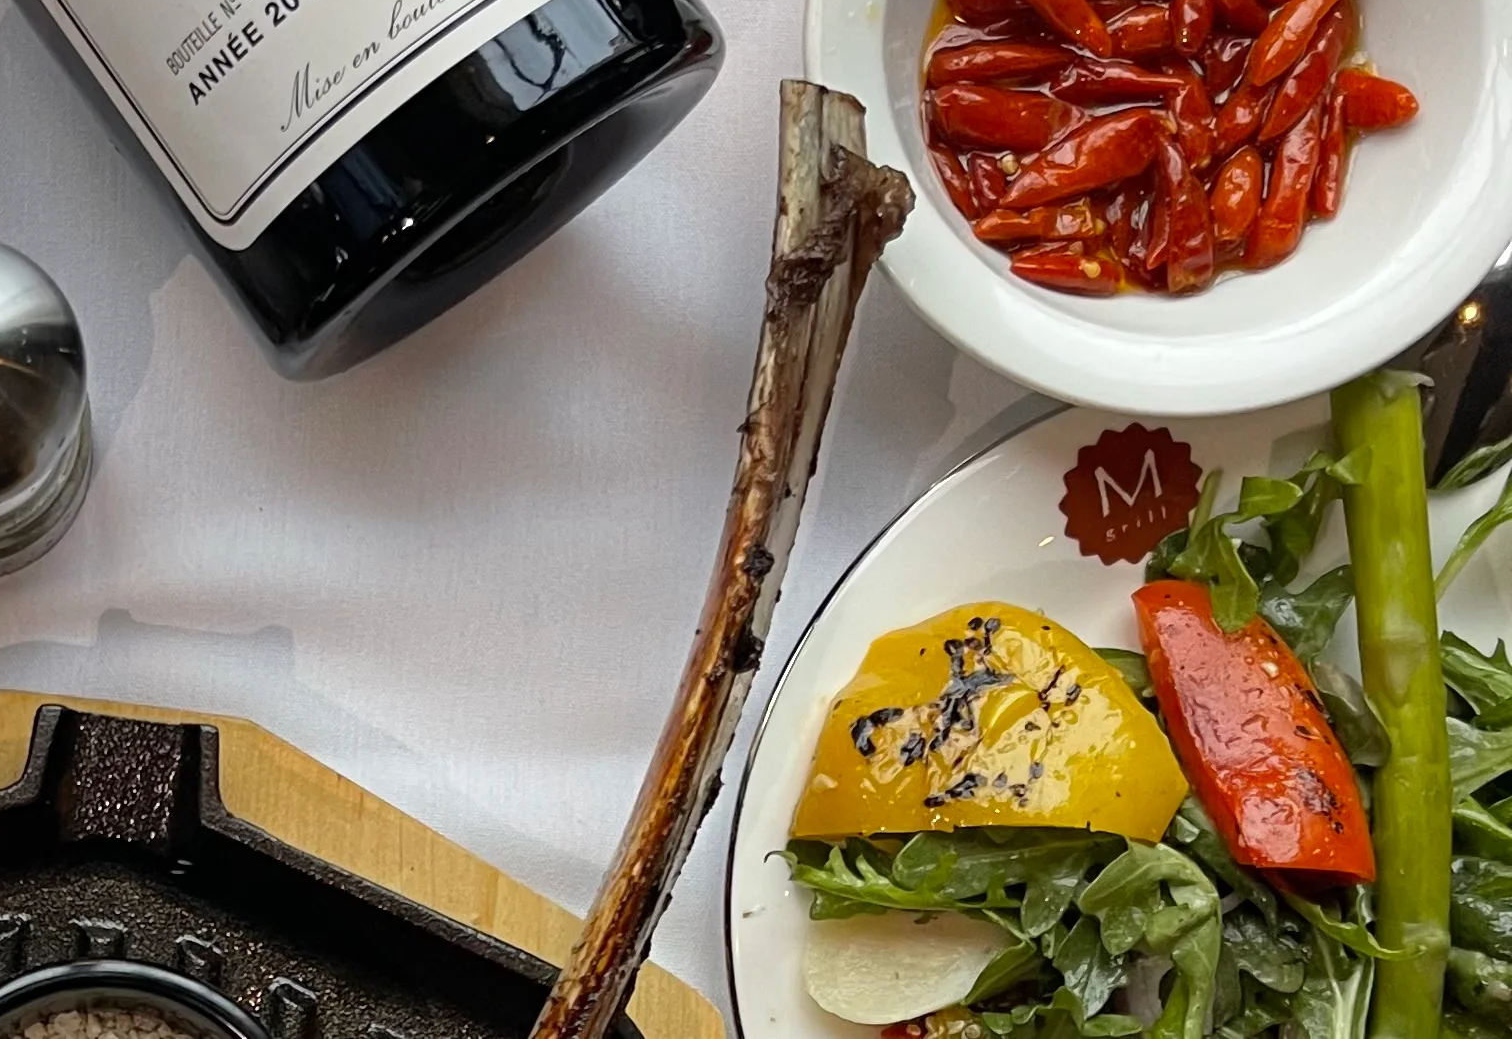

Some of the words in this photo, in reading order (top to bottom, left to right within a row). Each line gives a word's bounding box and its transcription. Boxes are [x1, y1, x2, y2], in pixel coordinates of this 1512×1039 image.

[165, 11, 223, 76] BOUTEILLE
[188, 20, 265, 107] ANNÉE
[280, 61, 346, 133] Mise
[352, 41, 381, 70] en
[1094, 448, 1163, 518] M
